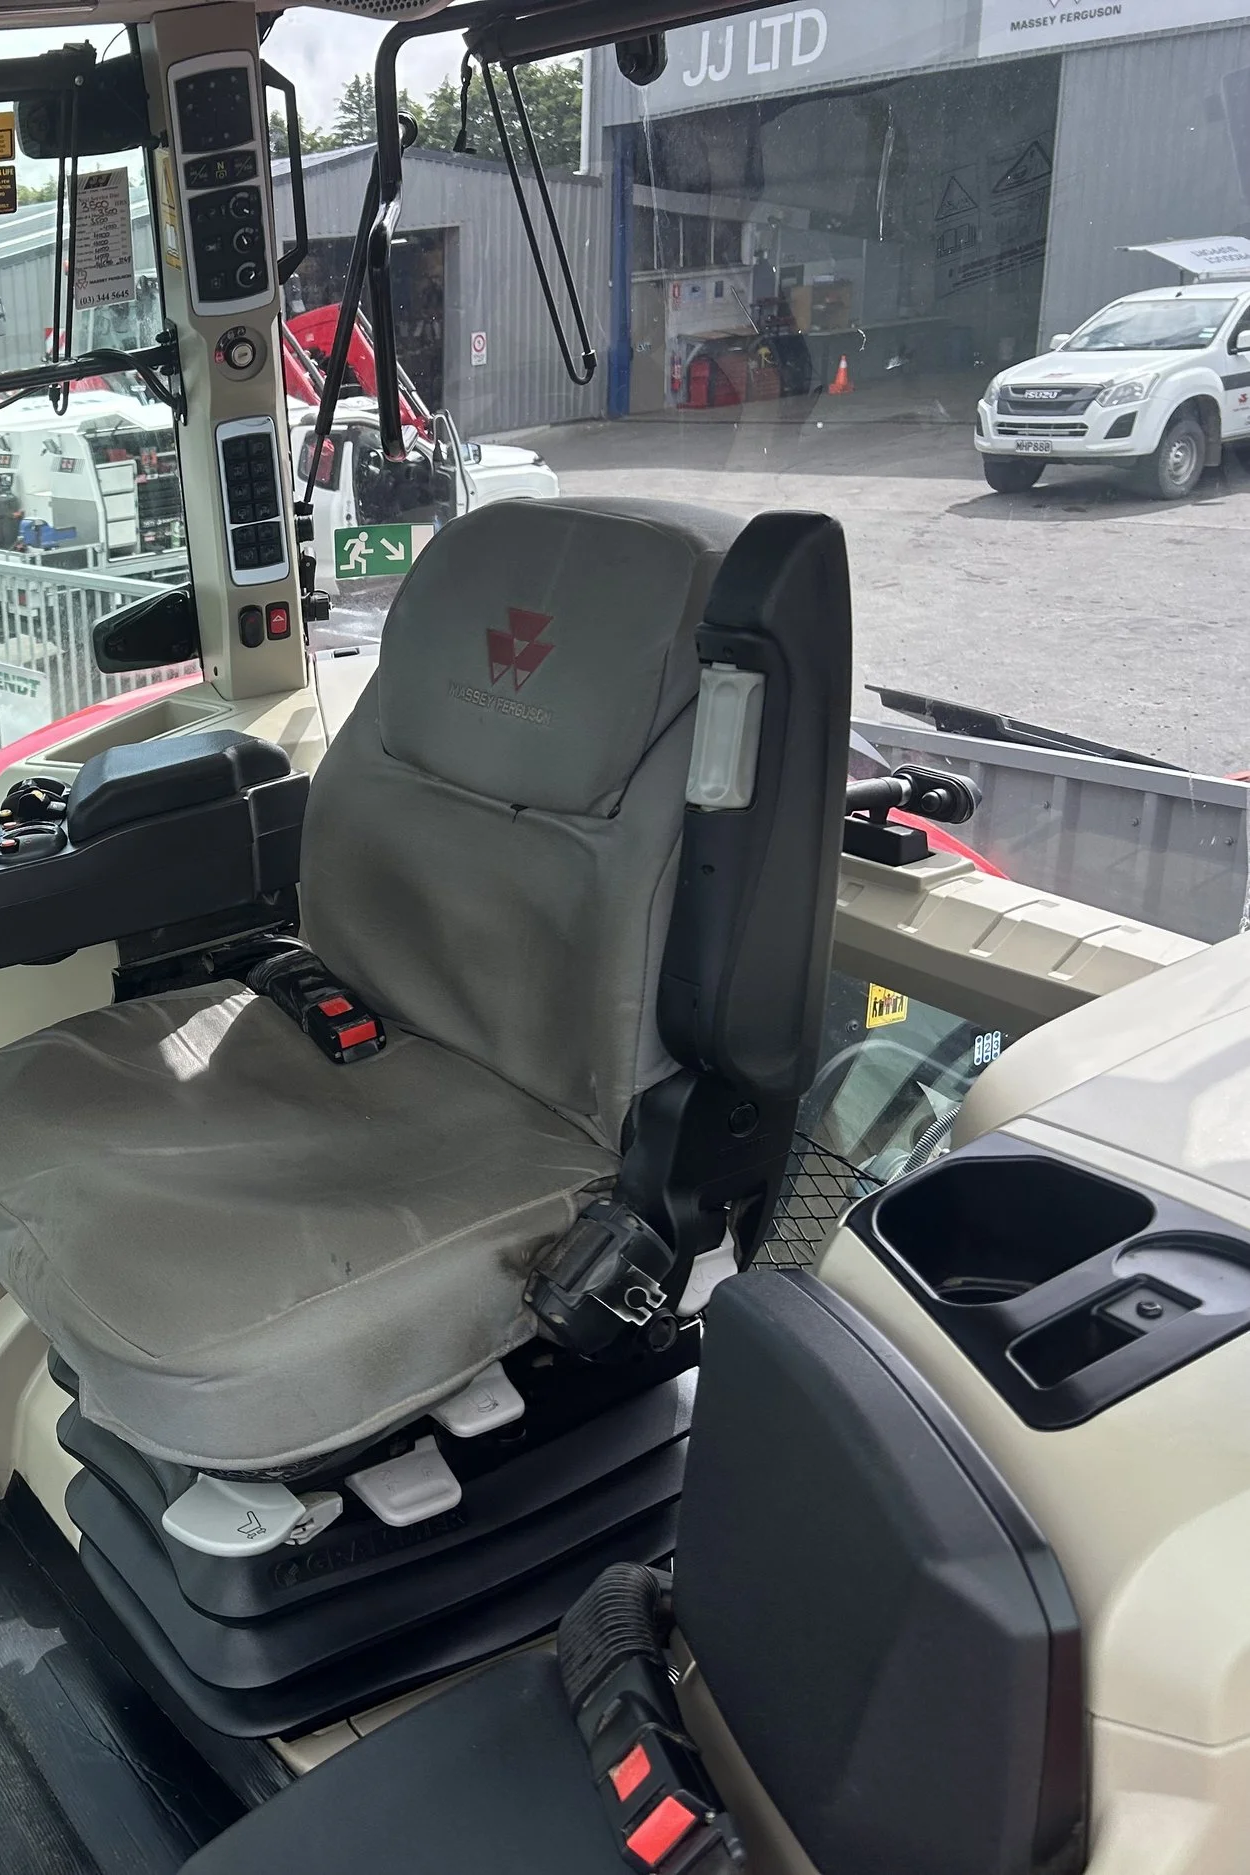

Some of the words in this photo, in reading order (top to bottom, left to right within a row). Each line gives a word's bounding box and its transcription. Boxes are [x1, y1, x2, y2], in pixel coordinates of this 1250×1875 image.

[1010, 16, 1056, 31] MASSEY
[1059, 5, 1122, 23] FERGUSON
[683, 25, 733, 87] JJ
[747, 8, 828, 74] LTD
[3, 168, 14, 176] LIFE
[80, 296, 95, 305] (03)
[111, 289, 129, 300] 5645
[1024, 391, 1059, 399] ISUZU
[449, 682, 494, 707] MASSEY
[495, 697, 552, 725] FERGUSON
[985, 1043, 991, 1053] 2
[993, 1040, 999, 1050] 3
